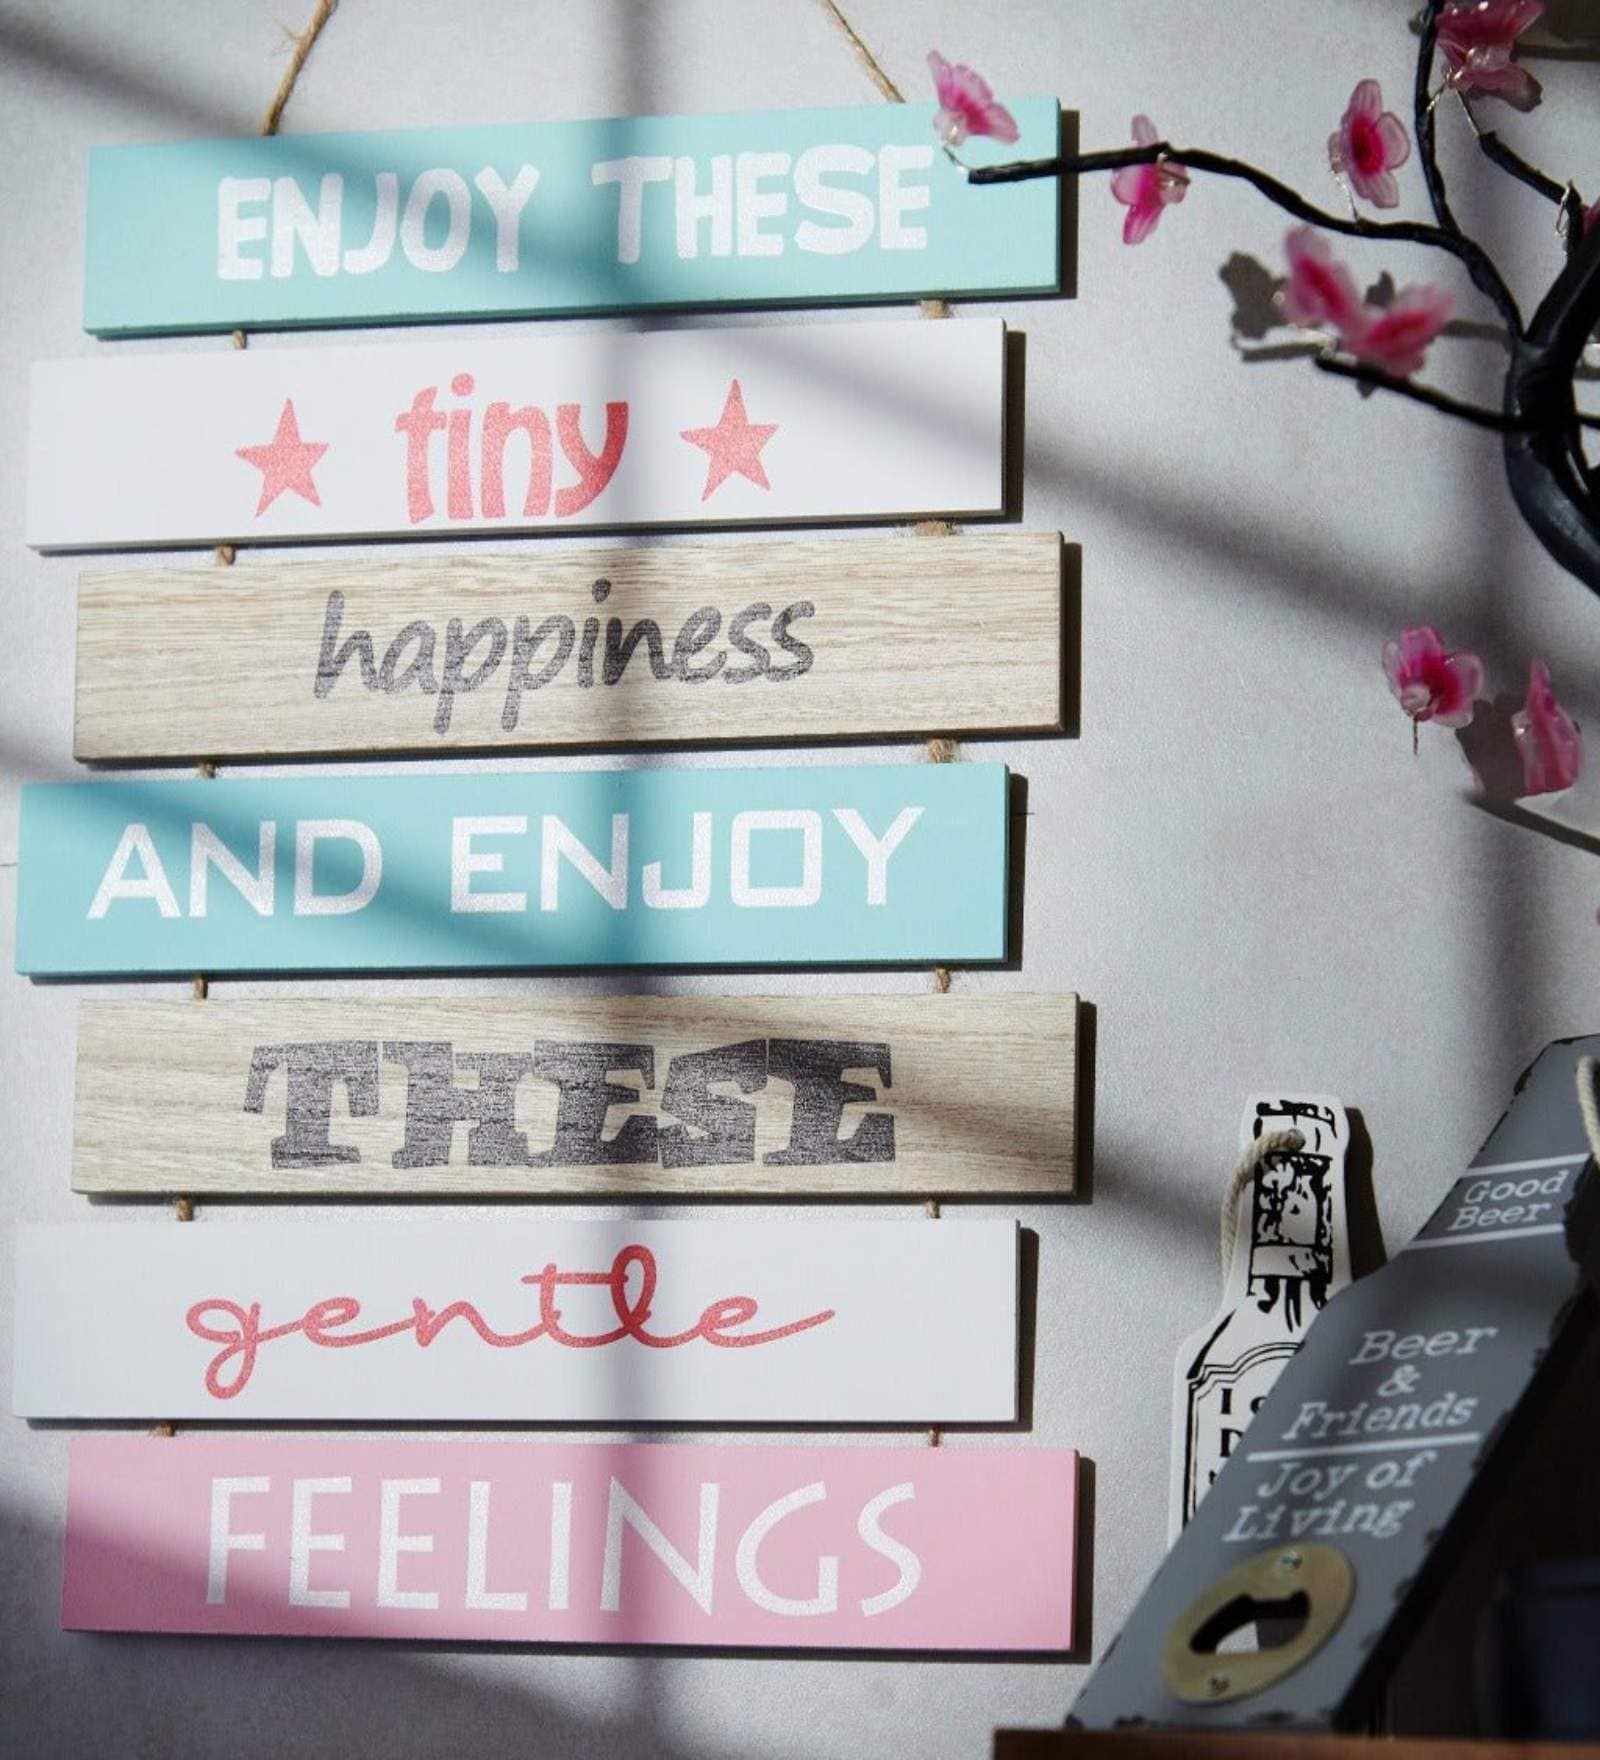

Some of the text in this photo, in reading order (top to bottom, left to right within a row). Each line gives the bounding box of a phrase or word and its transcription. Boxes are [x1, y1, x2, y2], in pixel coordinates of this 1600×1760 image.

[216, 143, 936, 282] ENJOY THESE
[394, 373, 629, 525] tiny
[313, 579, 817, 734] happiness
[87, 806, 926, 920] AND ENJOY
[243, 1038, 897, 1170] THESE
[1447, 1202, 1553, 1232] Beer
[1464, 1169, 1570, 1205] Good
[185, 1243, 837, 1401] gentle
[1347, 1326, 1499, 1365] Beer
[1280, 1391, 1479, 1441] Friends
[1376, 1363, 1423, 1398] &
[1256, 1461, 1360, 1501] Joy
[1364, 1449, 1439, 1490] of
[204, 1475, 923, 1618] FEELINGS
[1221, 1498, 1416, 1542] Living
